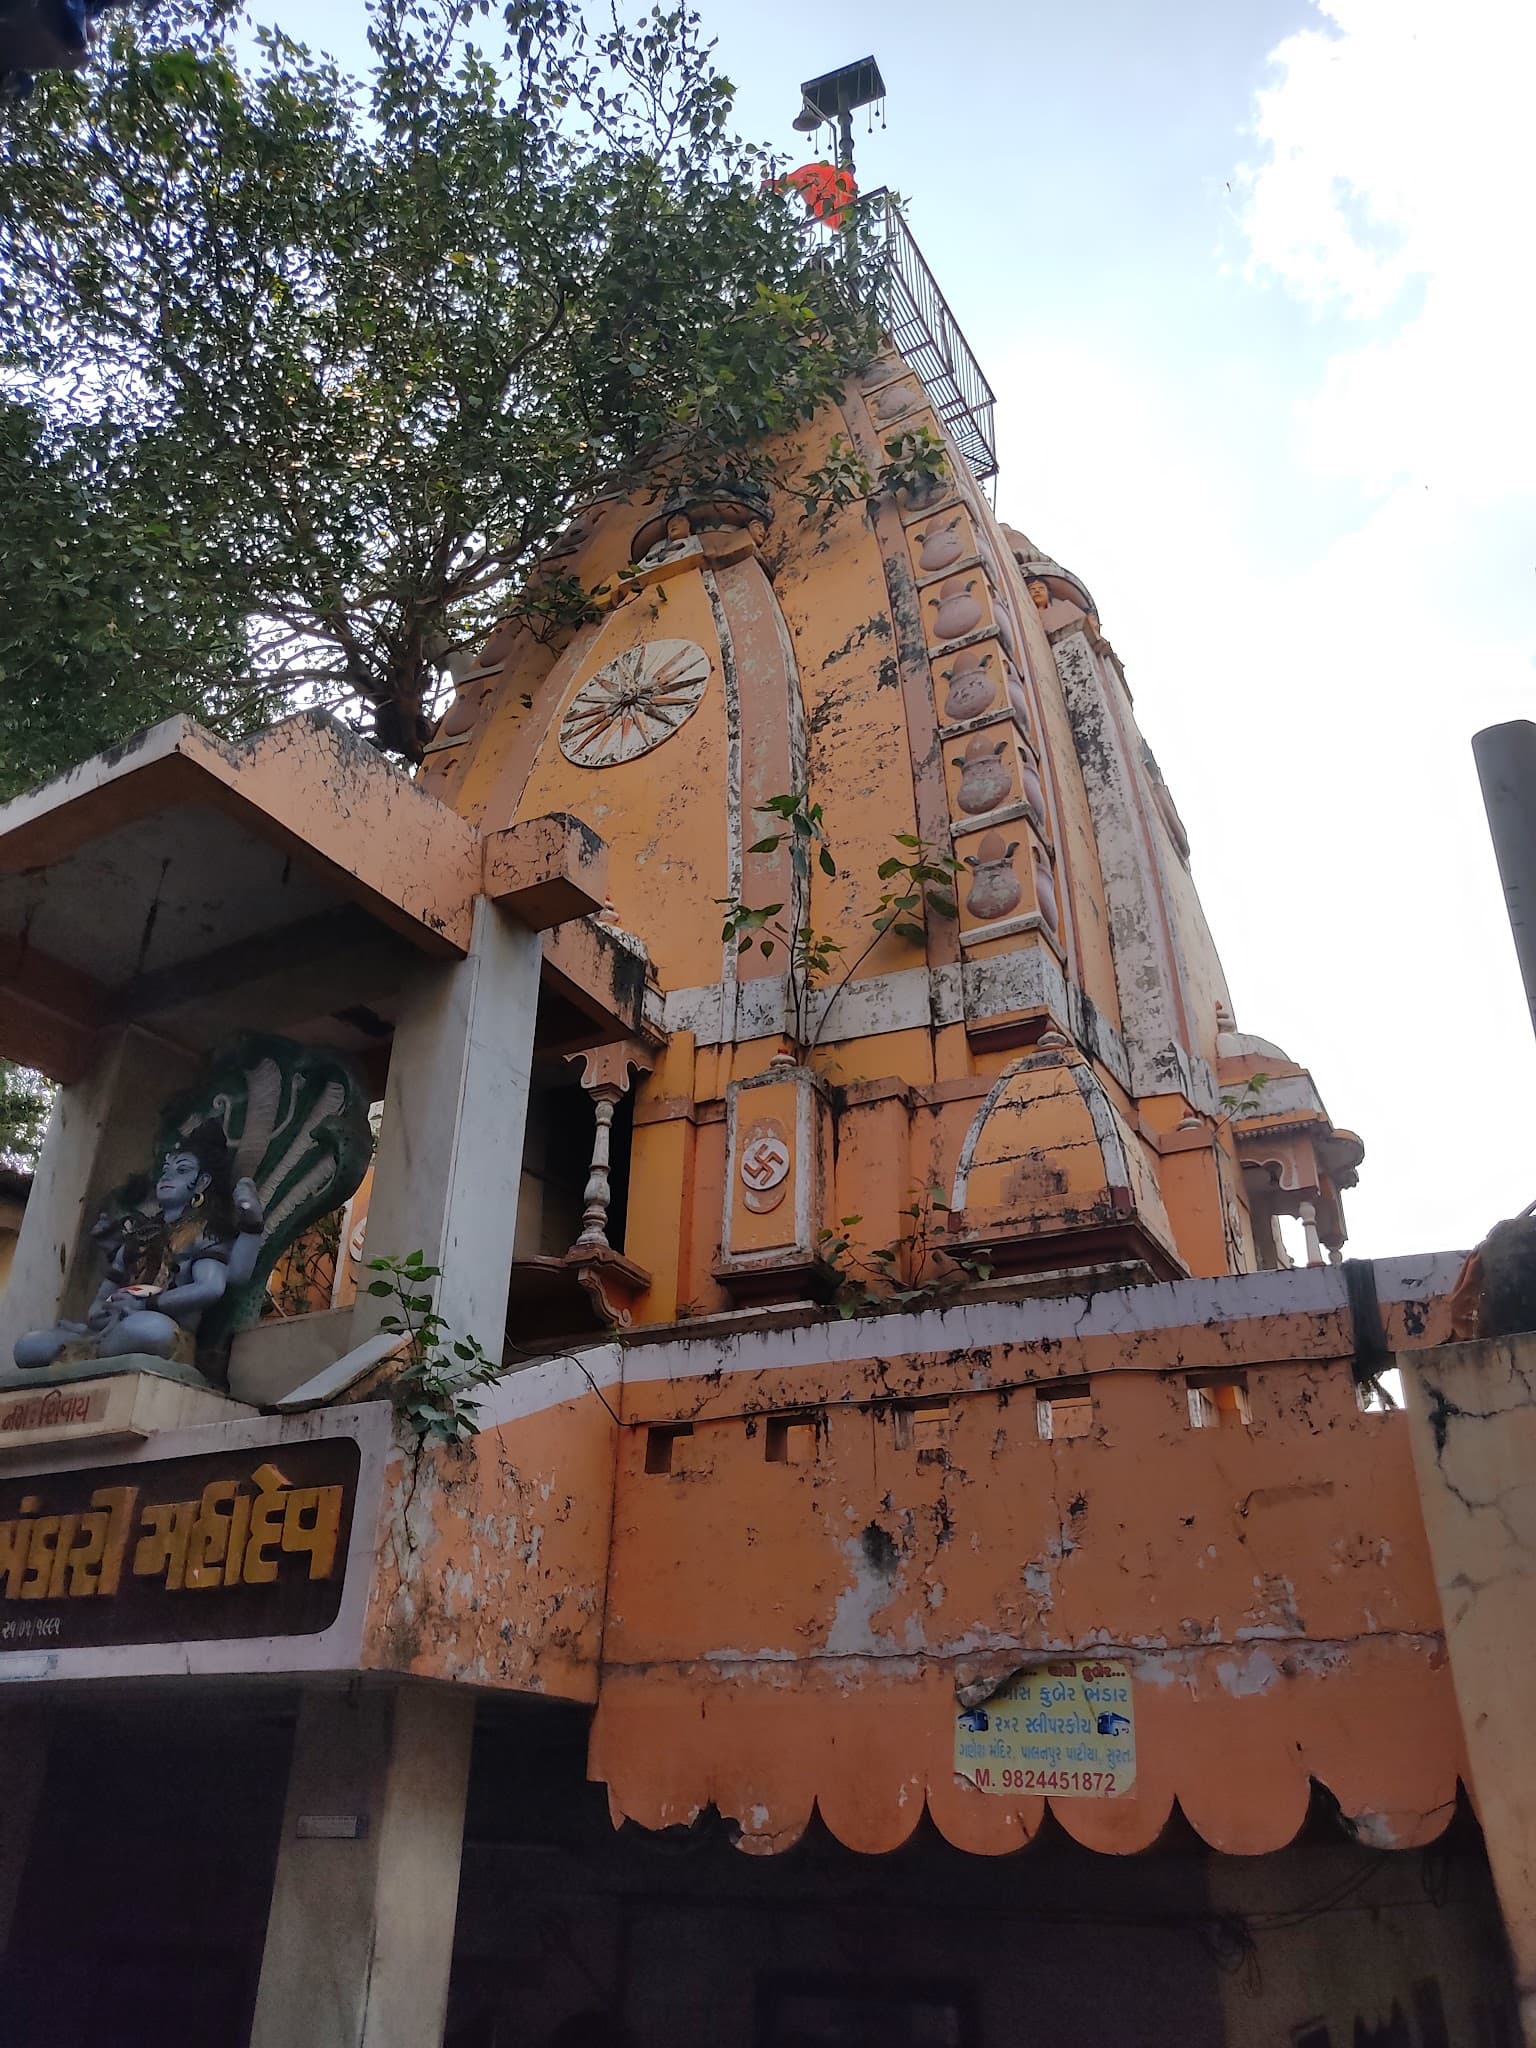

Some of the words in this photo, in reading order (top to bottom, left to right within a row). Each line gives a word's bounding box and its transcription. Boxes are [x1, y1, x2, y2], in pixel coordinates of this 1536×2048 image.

[1039, 1681, 1077, 1708] કુબેર
[975, 1768, 996, 1788] M.
[1002, 1769, 1117, 1792] 9824451872
